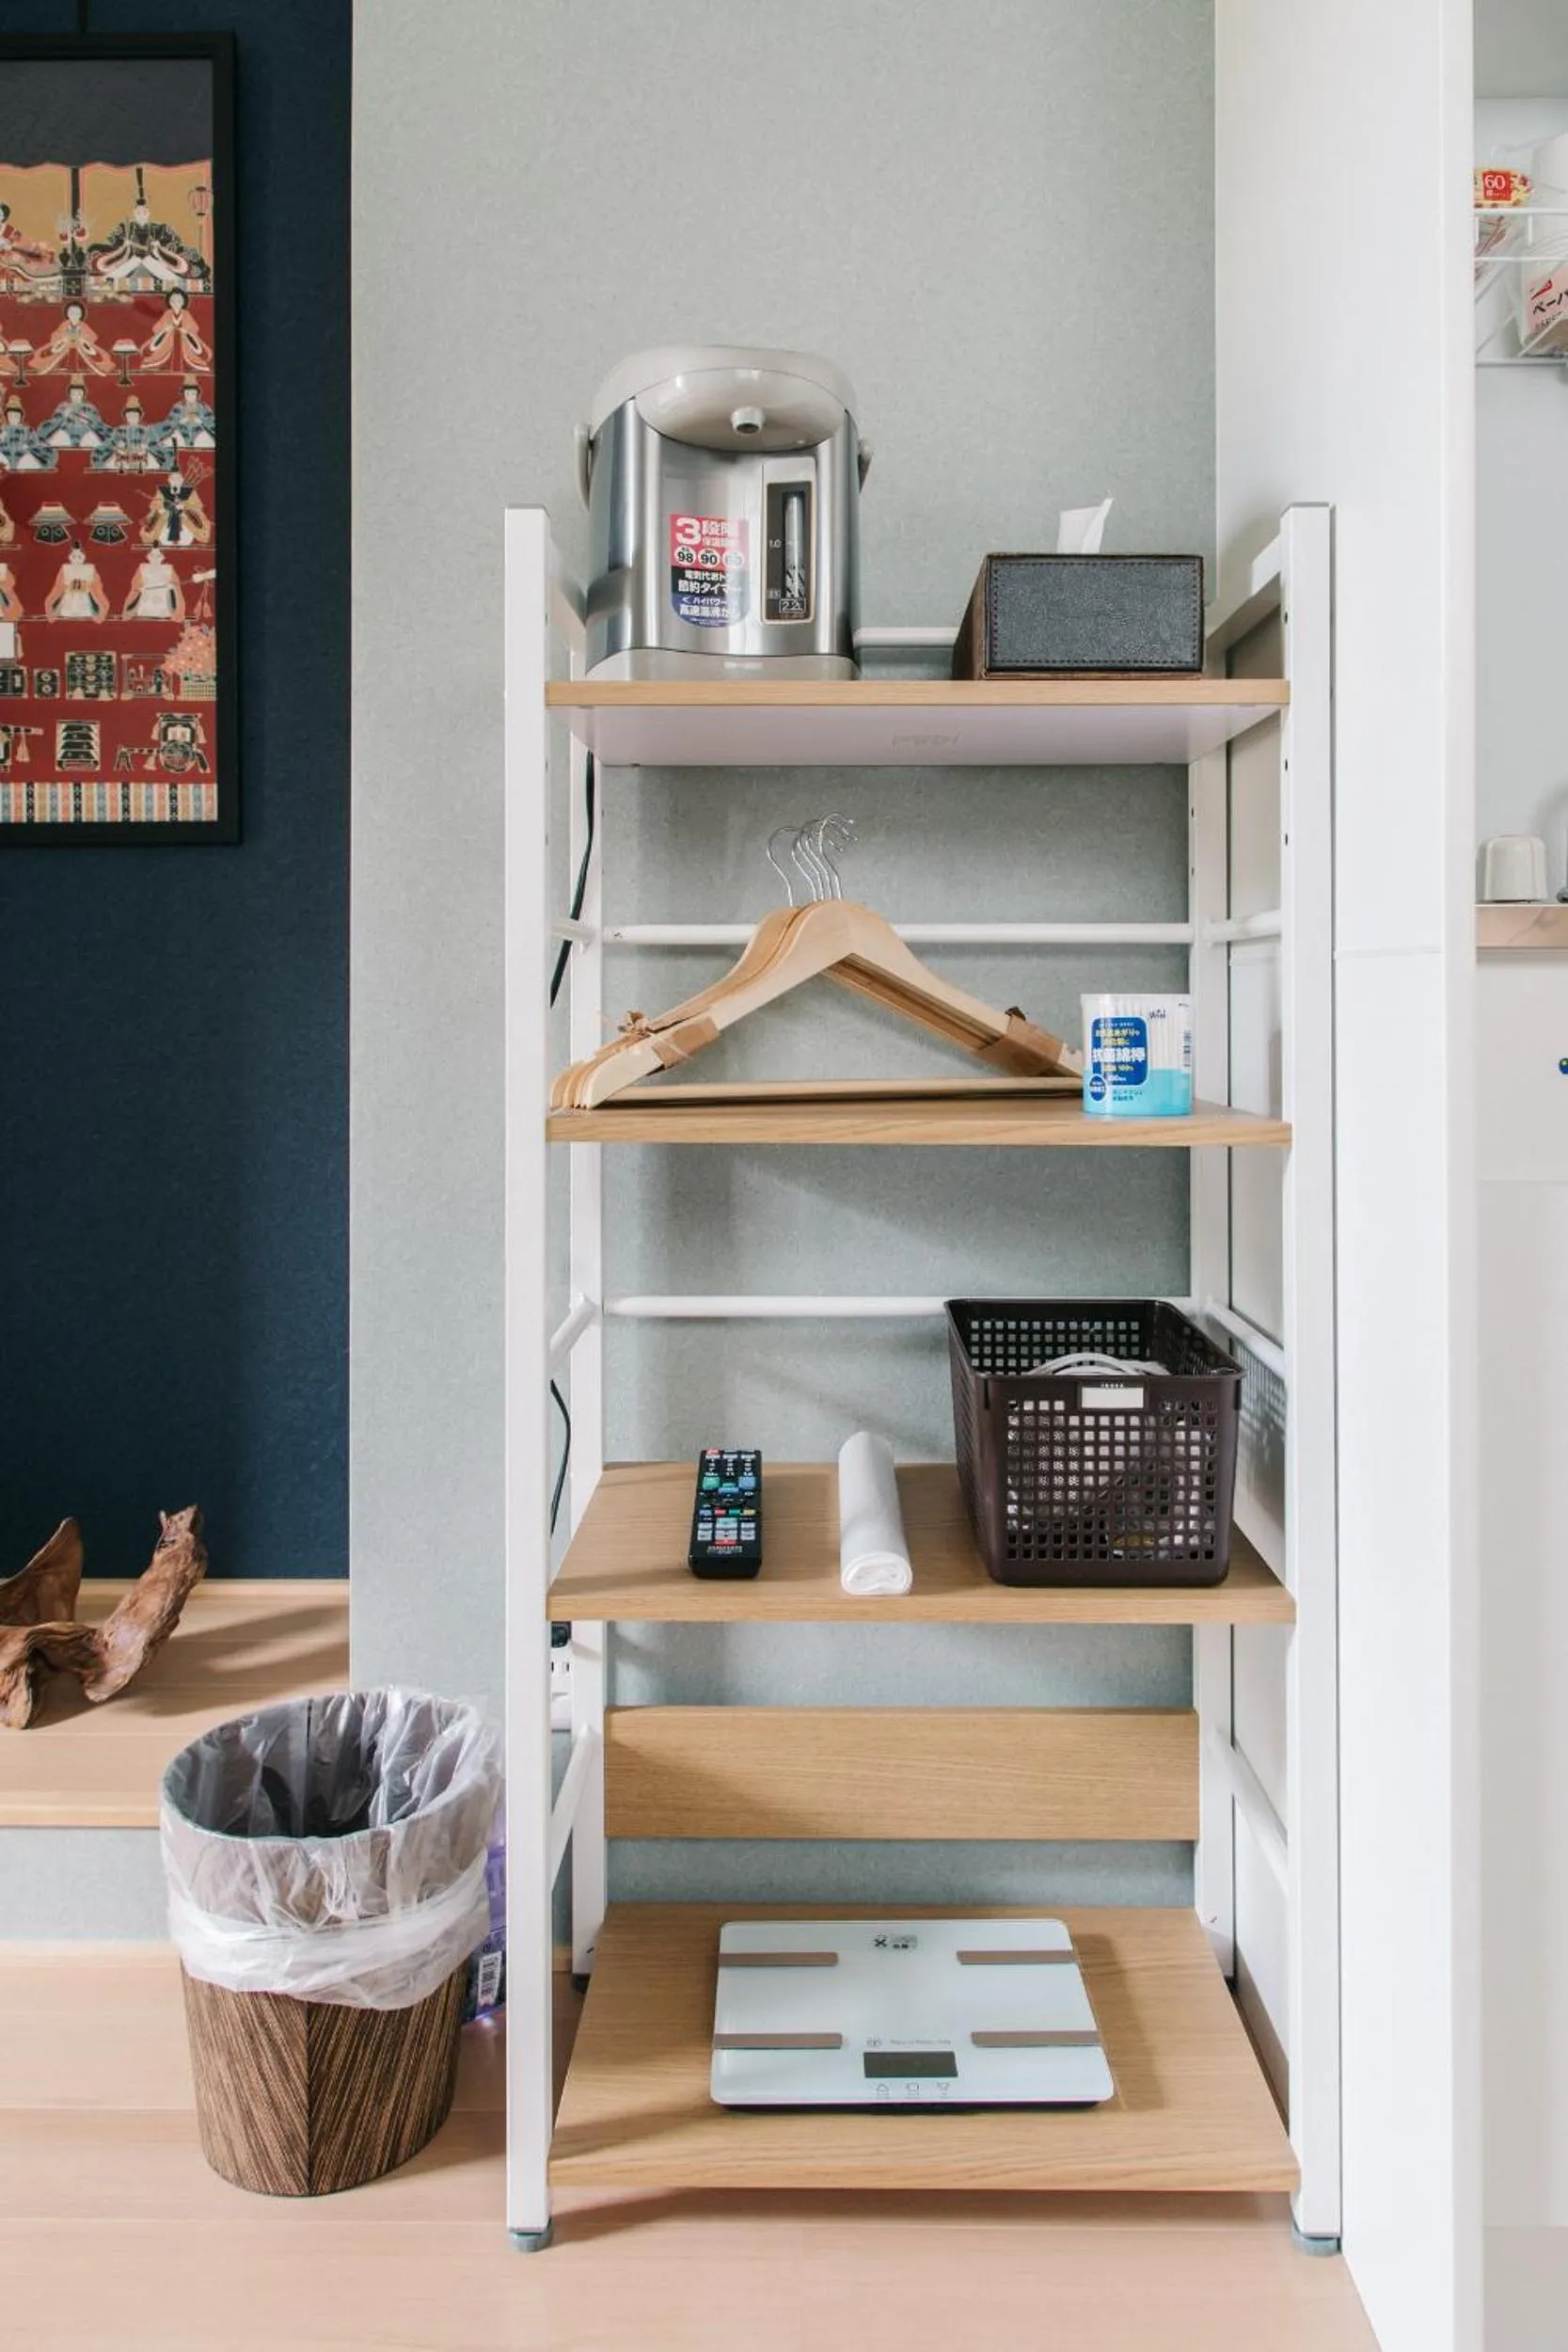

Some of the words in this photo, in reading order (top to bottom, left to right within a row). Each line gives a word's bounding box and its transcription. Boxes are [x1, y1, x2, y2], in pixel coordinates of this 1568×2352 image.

[1484, 174, 1506, 189] 60
[677, 551, 694, 564] 98
[701, 554, 718, 564] 90
